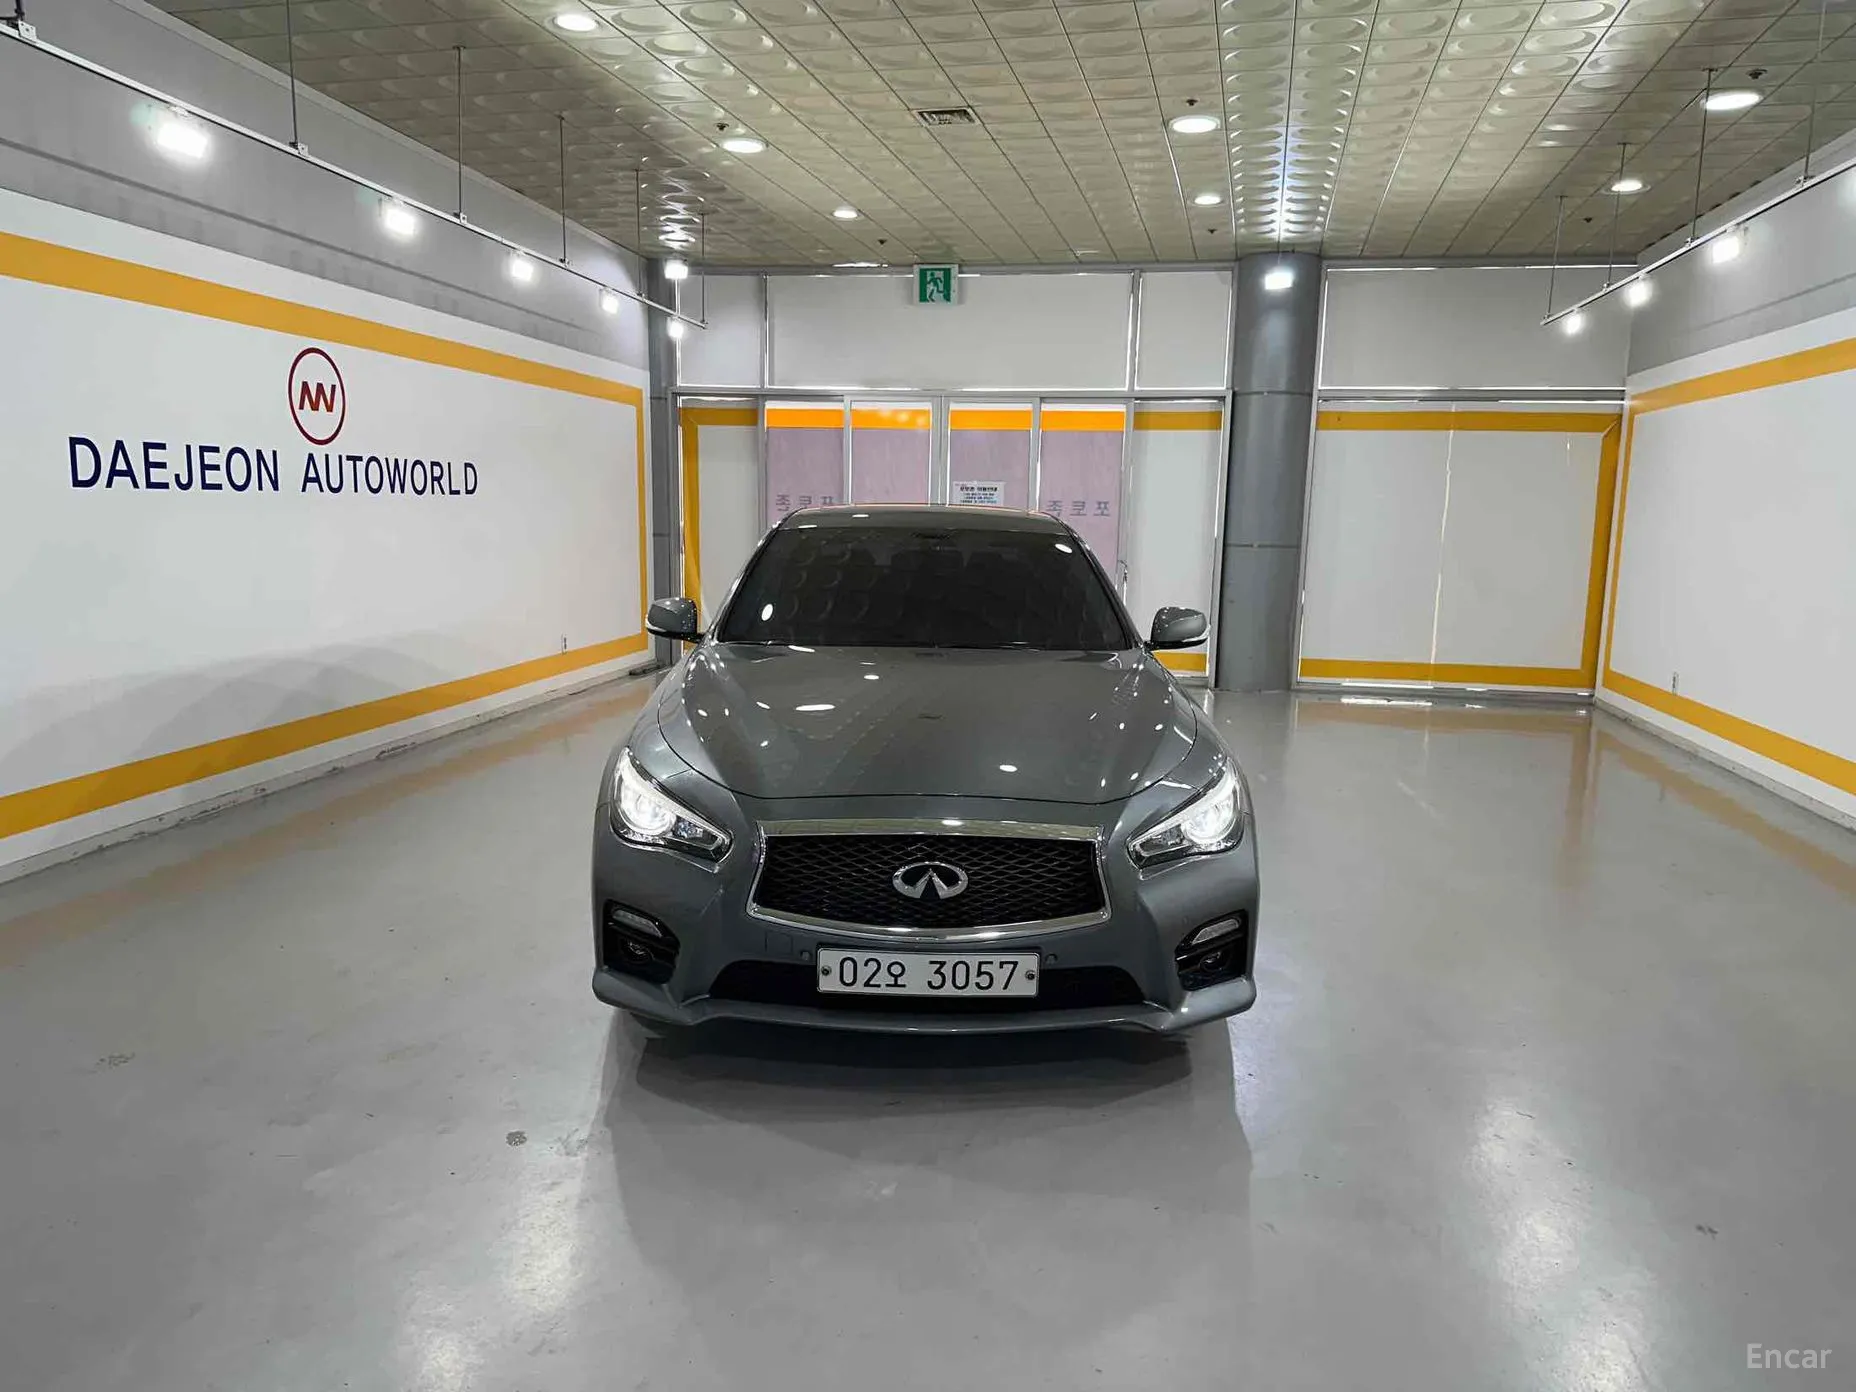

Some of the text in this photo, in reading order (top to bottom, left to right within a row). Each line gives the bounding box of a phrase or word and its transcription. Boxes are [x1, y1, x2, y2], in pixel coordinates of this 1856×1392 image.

[69, 436, 479, 496] DAEJEON AUTOWORLD
[838, 956, 1020, 991] 02오 3057
